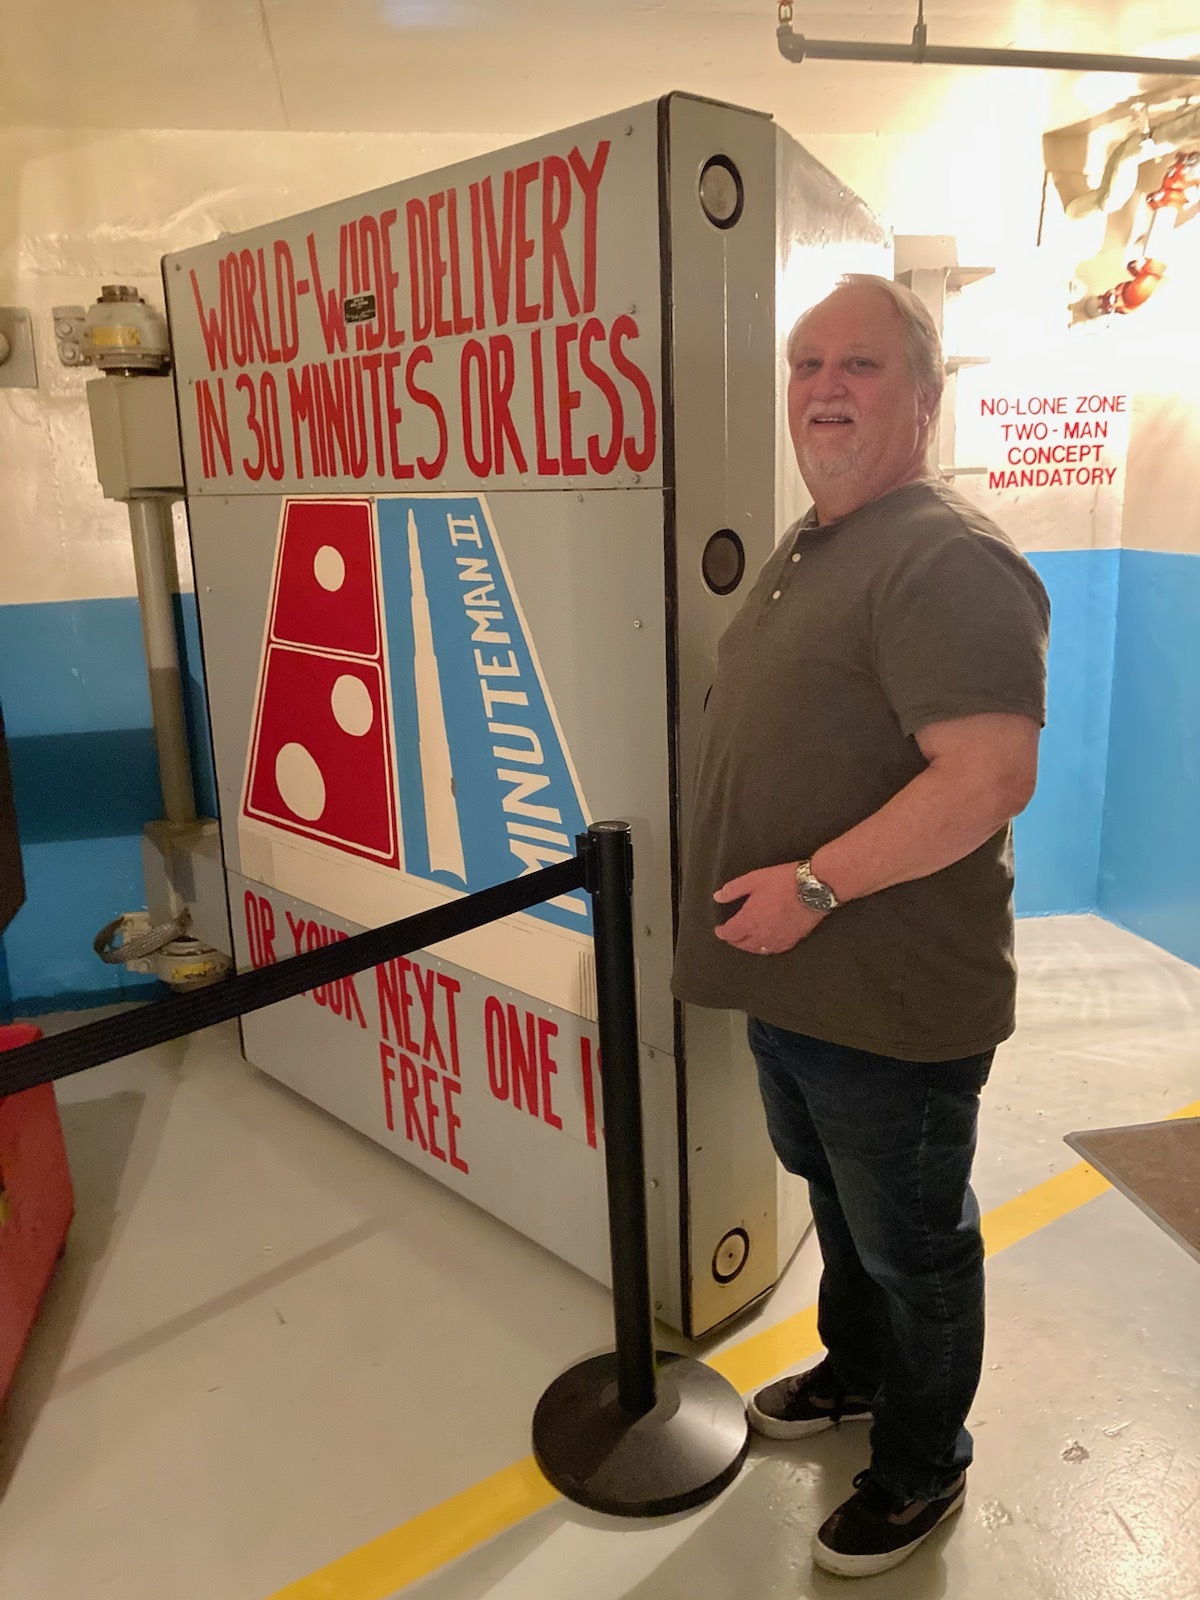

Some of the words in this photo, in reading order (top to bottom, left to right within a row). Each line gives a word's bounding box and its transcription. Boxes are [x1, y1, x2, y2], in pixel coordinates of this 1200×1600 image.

[406, 140, 611, 343] DELIVERY
[195, 379, 234, 479] IN
[236, 370, 285, 481] 30
[287, 345, 448, 480] MINUTES
[460, 335, 529, 478] OR
[530, 314, 657, 476] LESS
[980, 396, 1068, 416] NO-LONE
[1075, 395, 1127, 414] ZONE
[1007, 444, 1105, 465] CONCEPT
[988, 467, 1118, 489] MANDATORY
[243, 889, 277, 971] OR
[375, 956, 461, 1078] NEXT
[484, 995, 563, 1131] ONE
[580, 1036, 606, 1150] I
[379, 1040, 469, 1175] FREE
